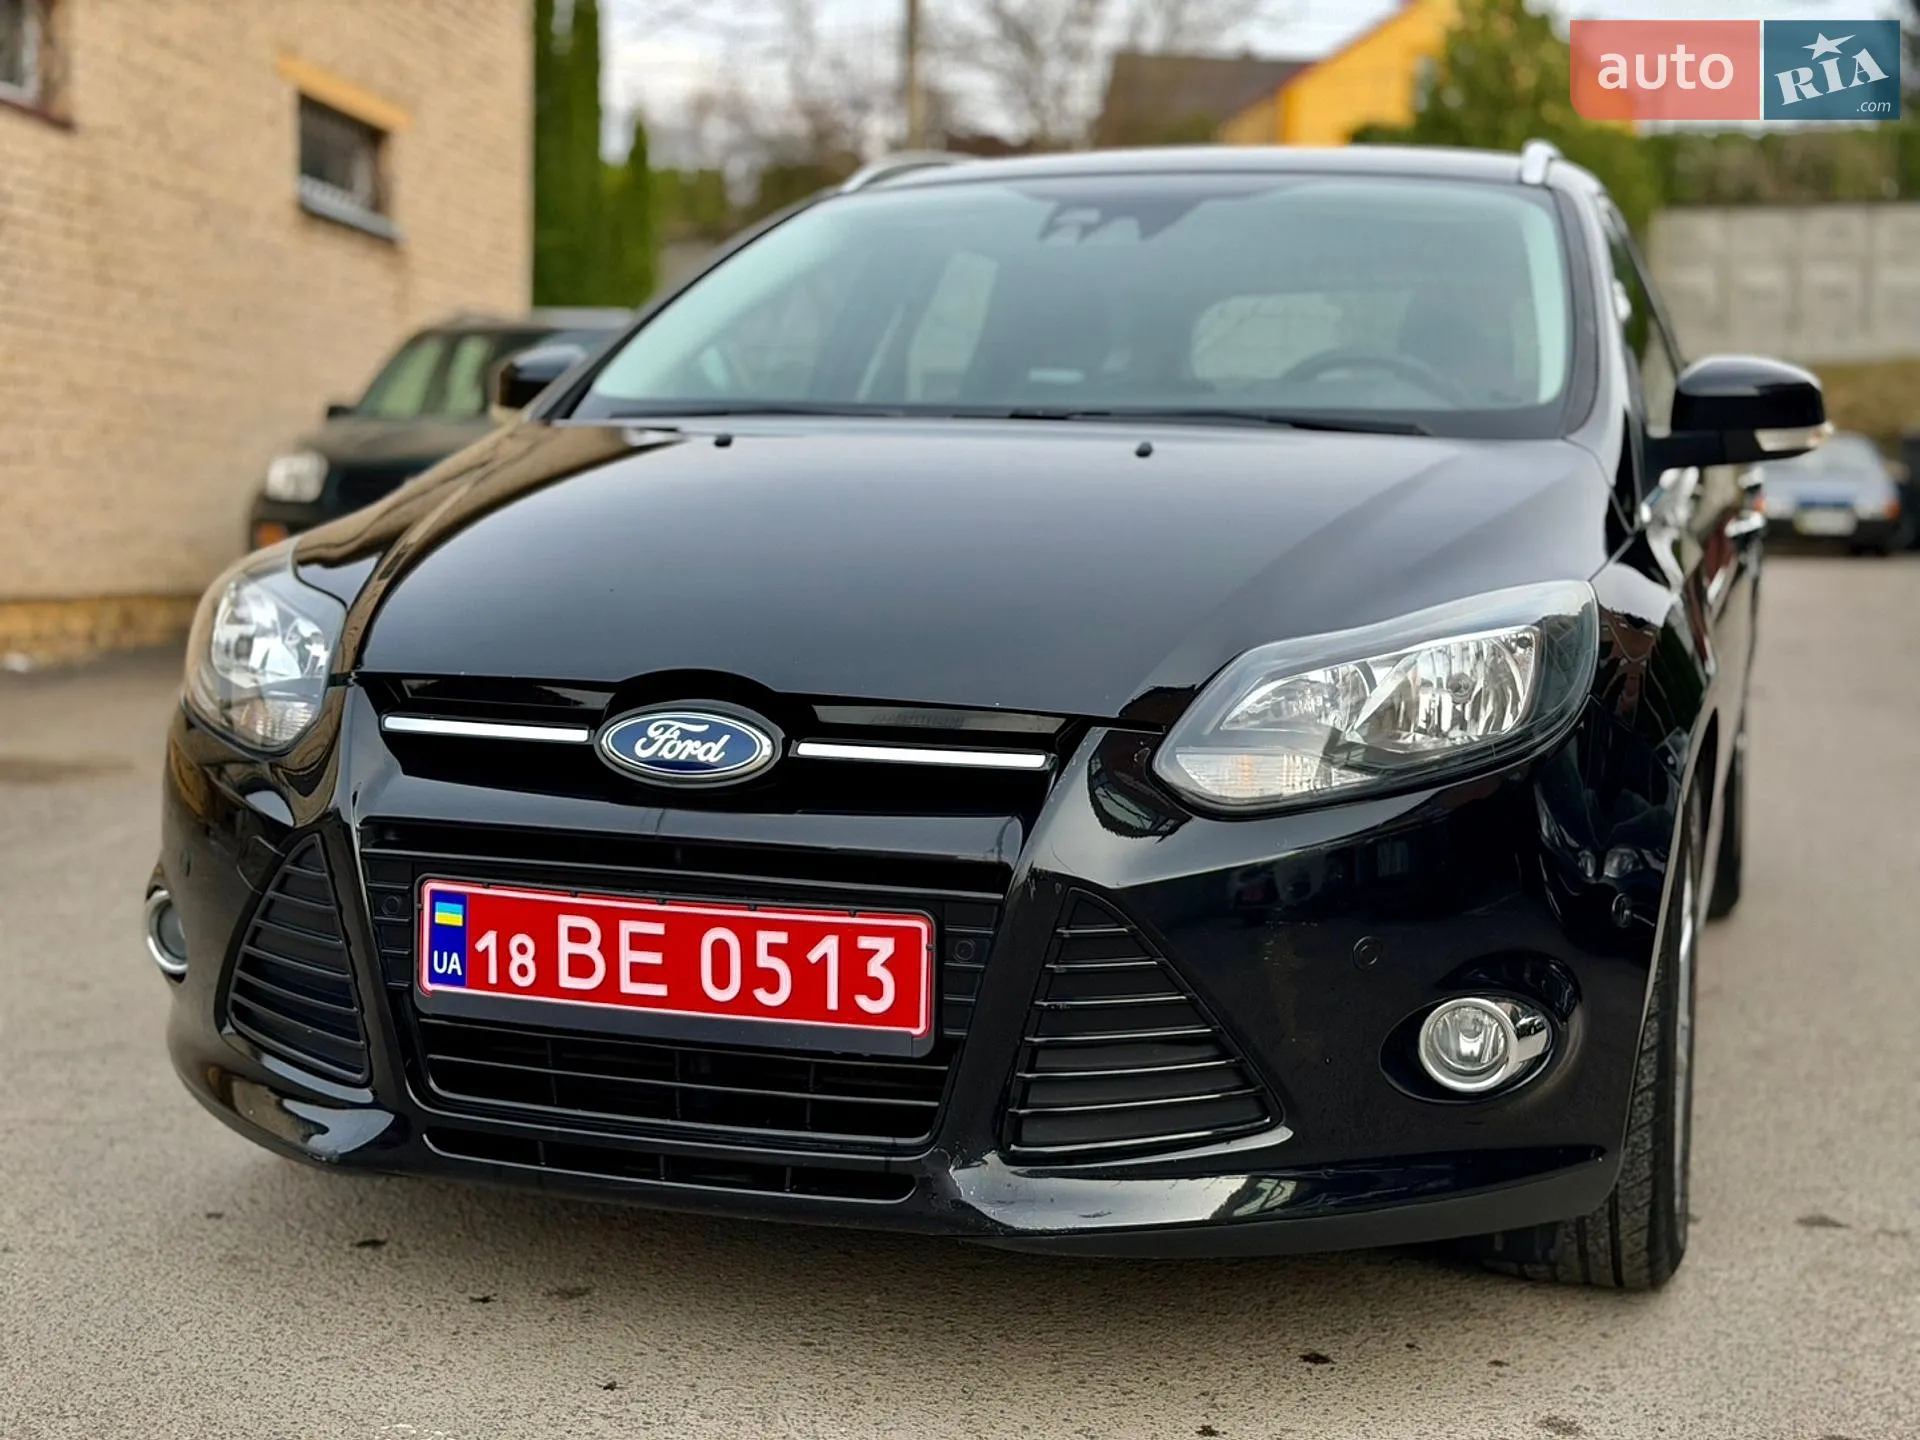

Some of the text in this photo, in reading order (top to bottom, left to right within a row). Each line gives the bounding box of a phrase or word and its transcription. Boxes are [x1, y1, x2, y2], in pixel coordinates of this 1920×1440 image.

[634, 720, 731, 763] Ford
[434, 950, 462, 977] UA
[474, 914, 895, 1015] 18 BE 0513
